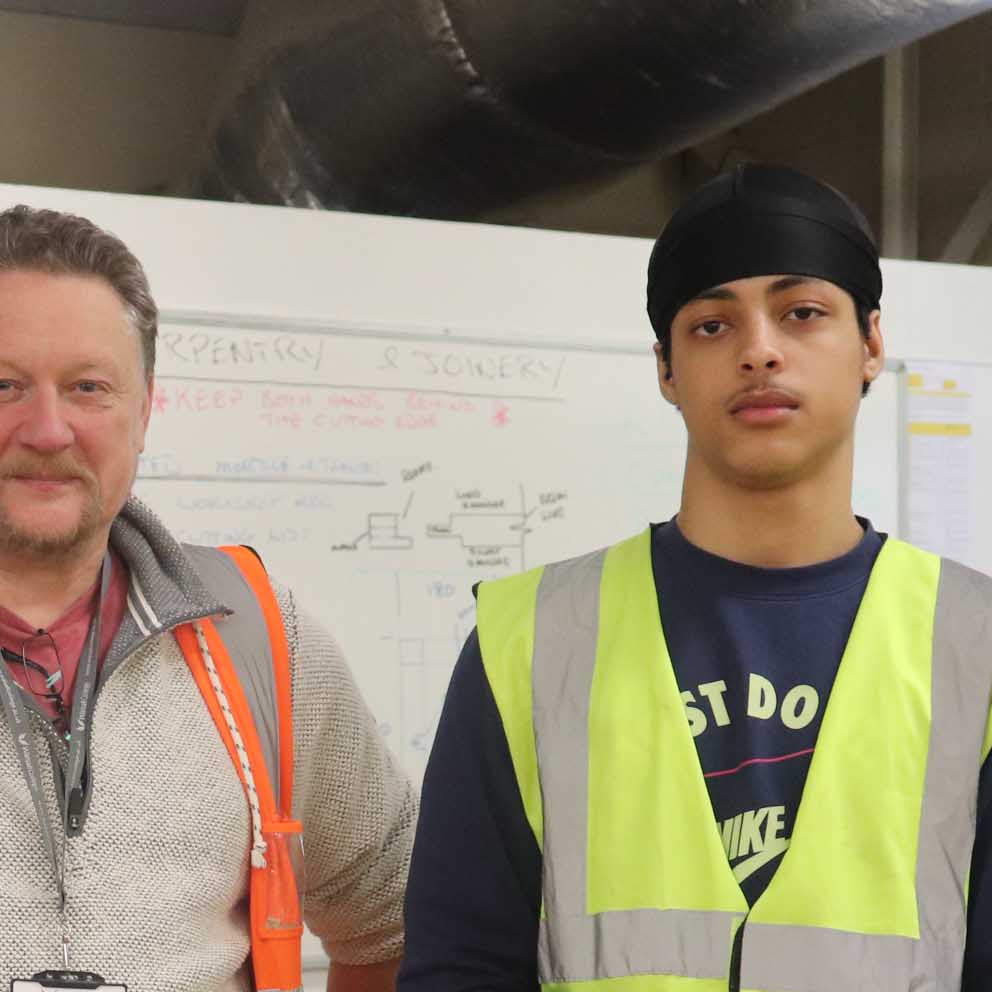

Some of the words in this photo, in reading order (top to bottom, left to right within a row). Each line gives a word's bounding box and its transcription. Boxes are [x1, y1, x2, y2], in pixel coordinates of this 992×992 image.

[161, 331, 326, 372] RPENTRY
[679, 680, 732, 737] ST
[746, 672, 820, 730] DO
